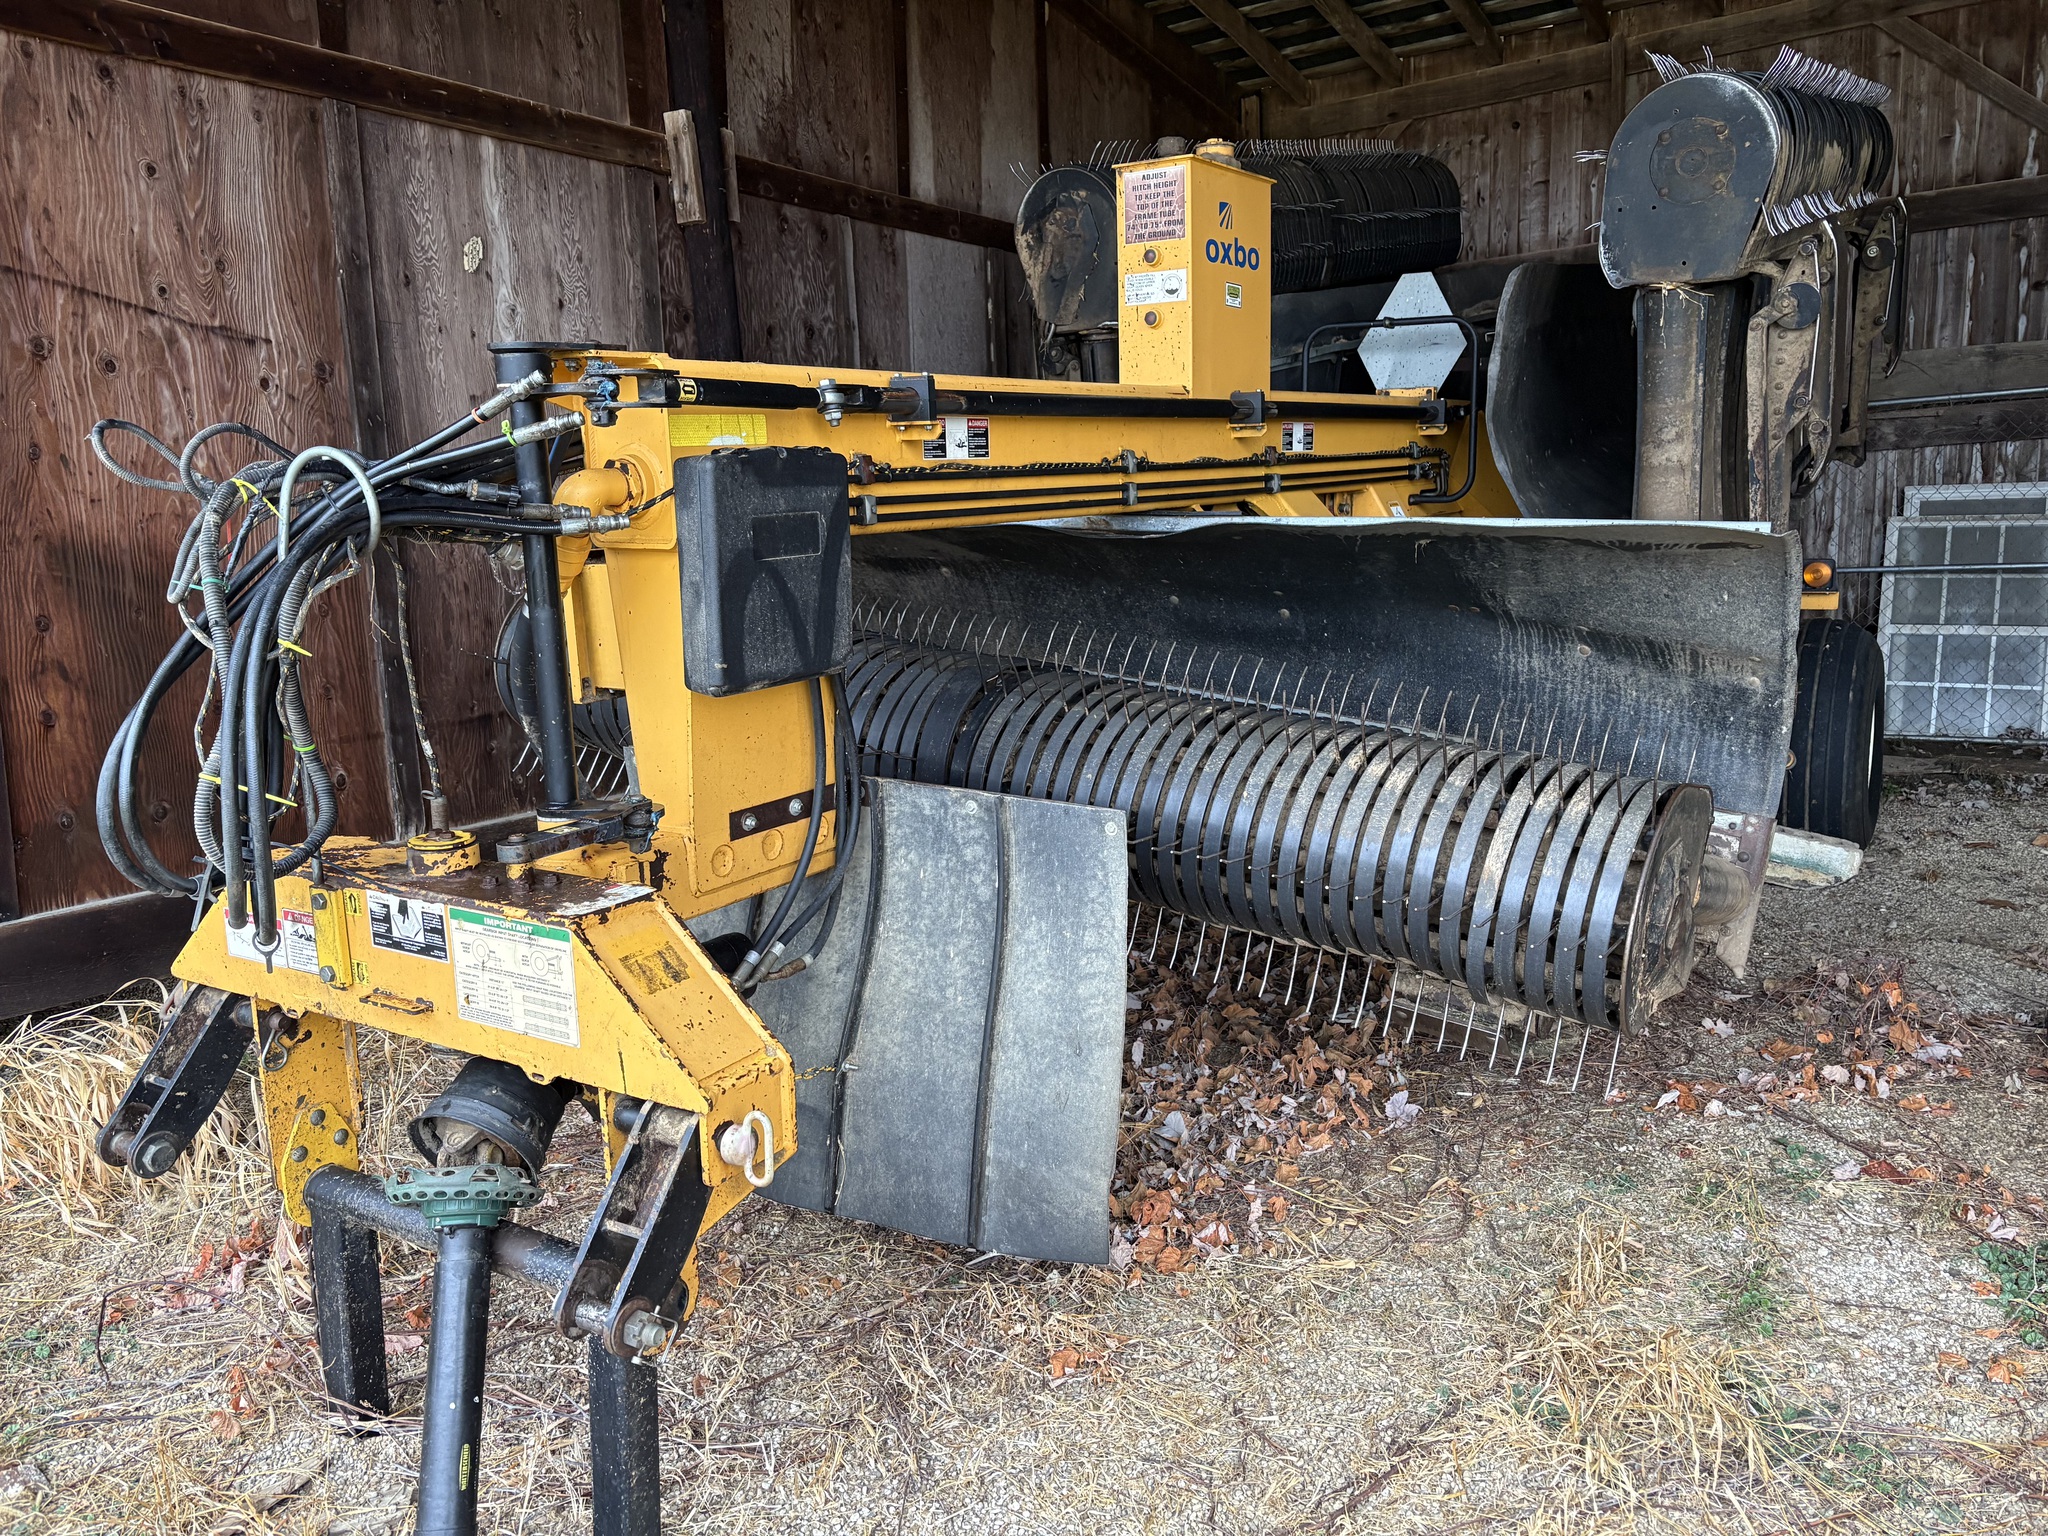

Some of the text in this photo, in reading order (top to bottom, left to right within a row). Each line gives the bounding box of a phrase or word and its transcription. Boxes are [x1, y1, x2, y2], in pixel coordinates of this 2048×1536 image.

[1142, 172, 1167, 181] ADJUST
[1154, 180, 1177, 189] HEIGHT
[1159, 210, 1175, 218] TUBE
[1164, 219, 1183, 227] FROM
[1148, 229, 1176, 238] GROUND
[1206, 237, 1260, 271] oxbo
[484, 917, 533, 933] IMPORTANT
